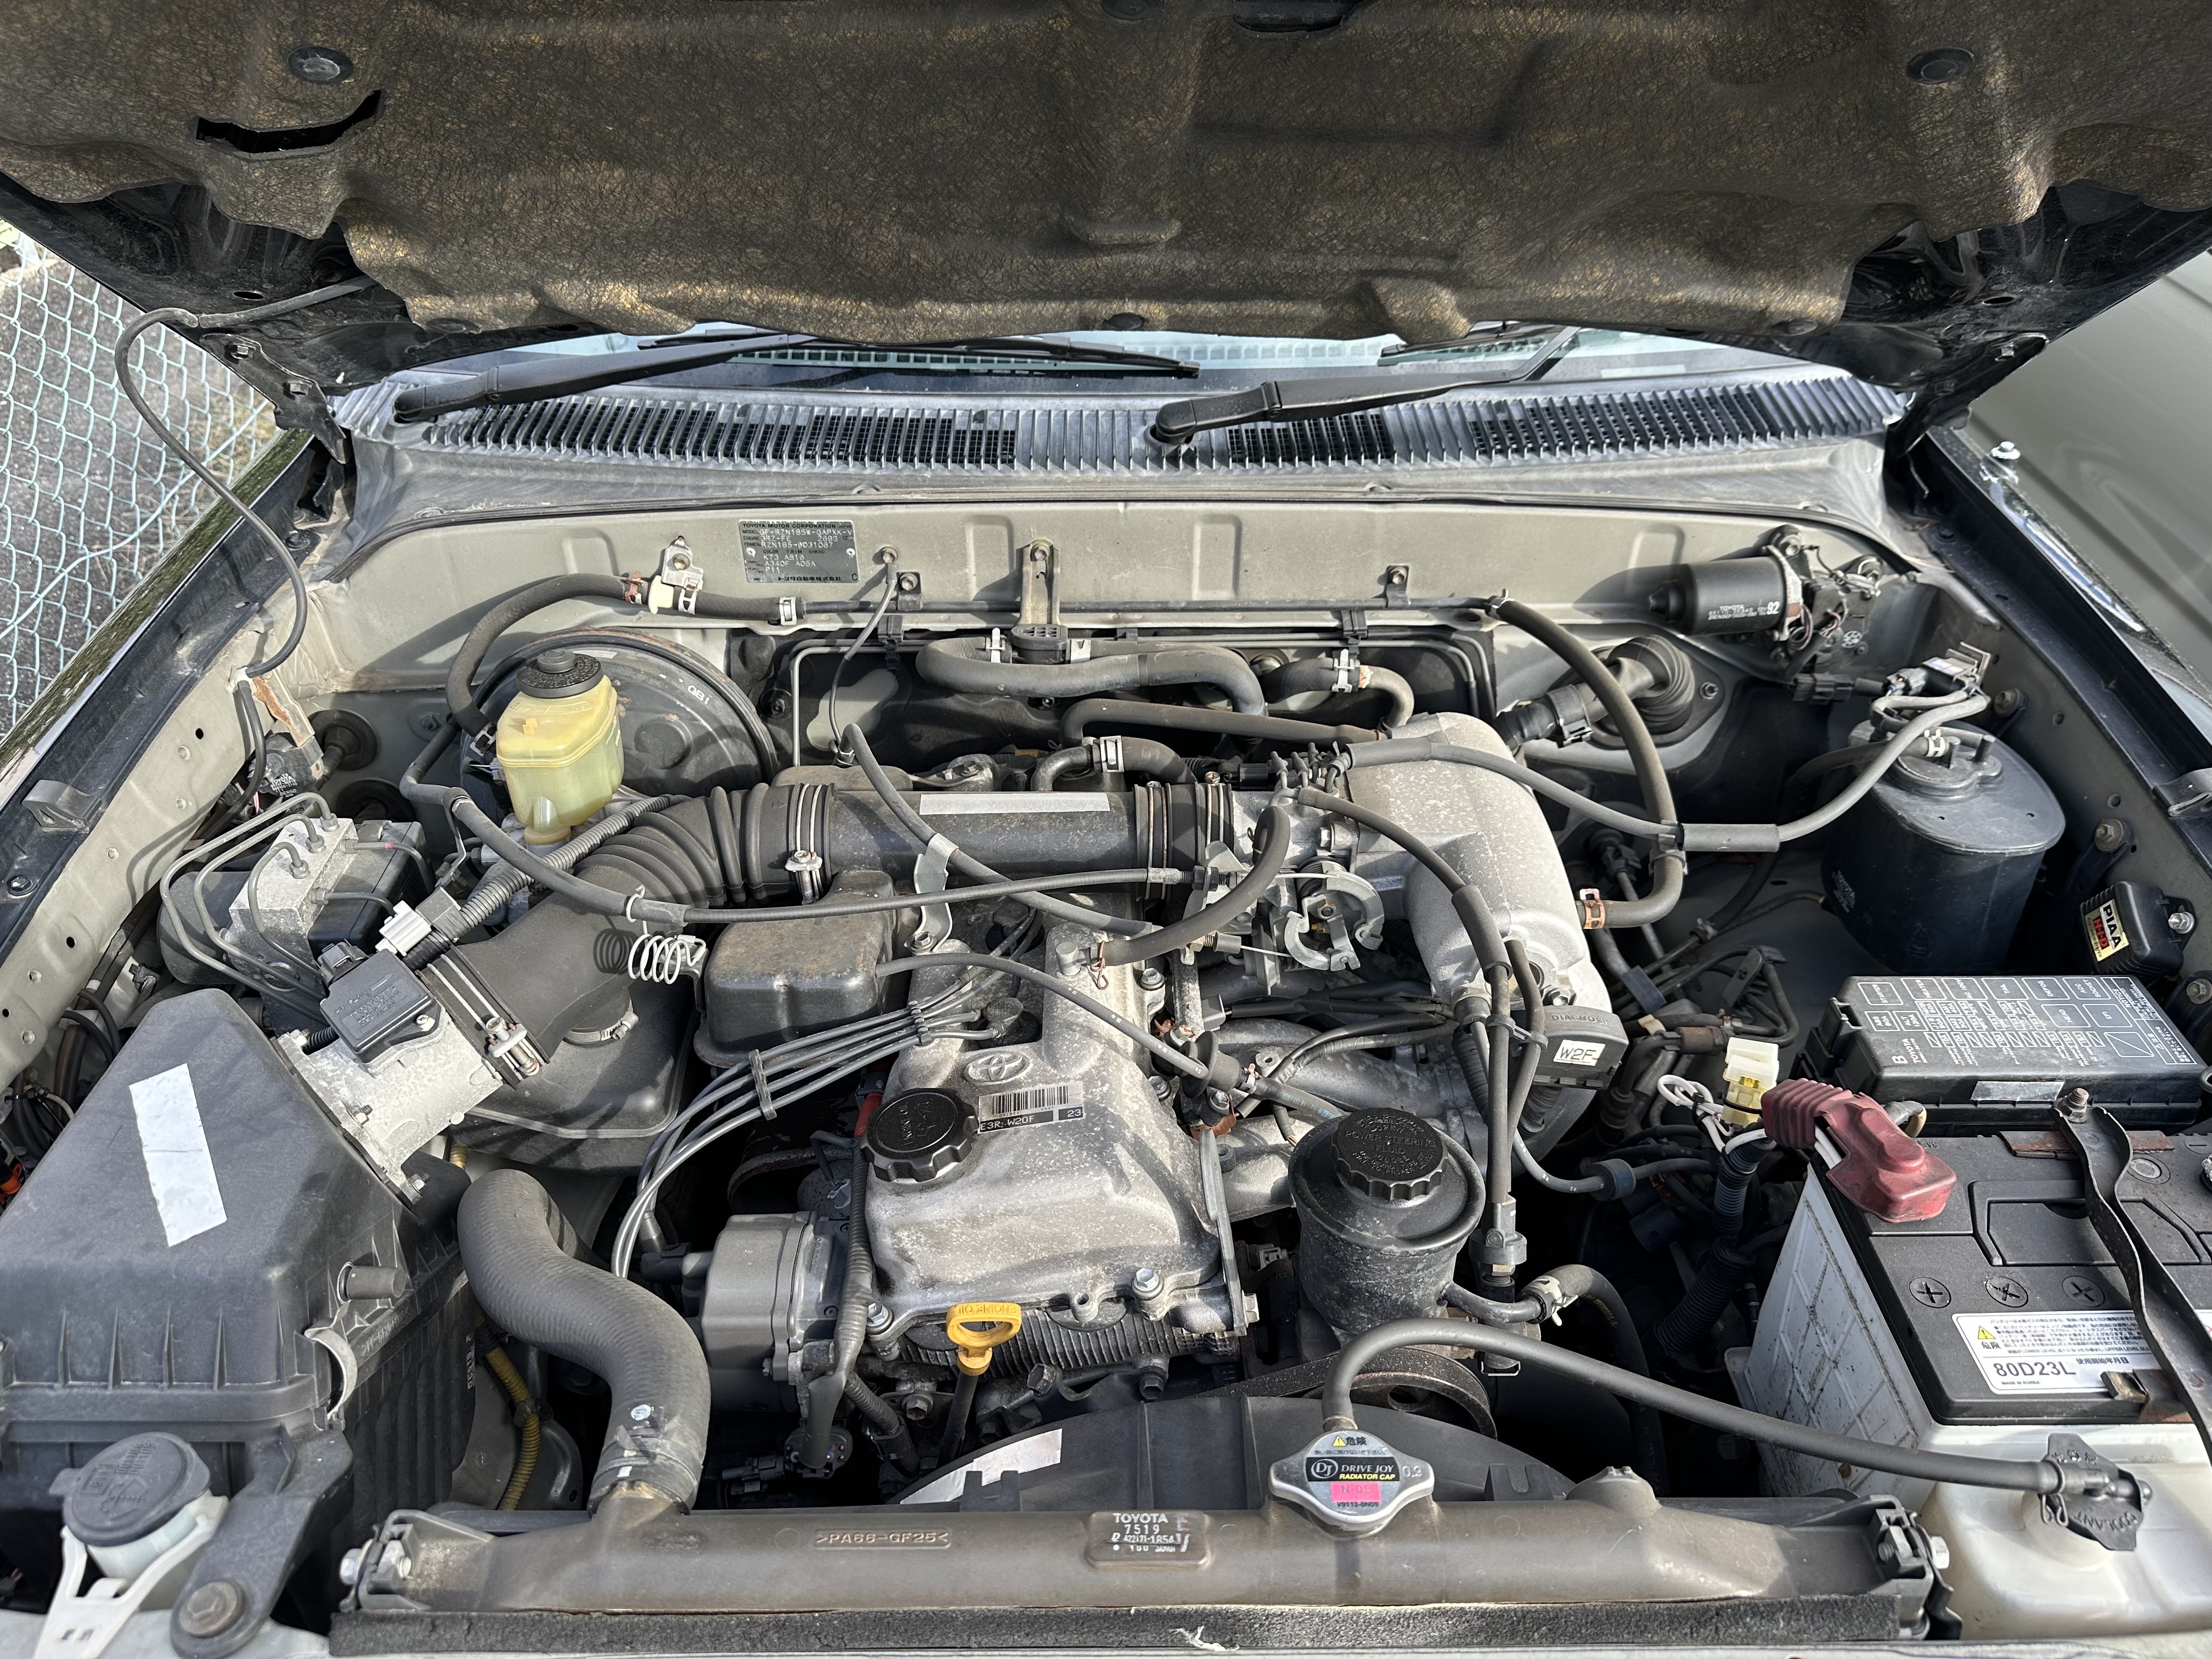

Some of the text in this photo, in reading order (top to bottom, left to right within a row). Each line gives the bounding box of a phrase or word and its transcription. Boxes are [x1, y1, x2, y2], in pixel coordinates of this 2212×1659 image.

[1767, 601, 1780, 614] 92
[2103, 904, 2121, 948] PIAA
[1871, 984, 1888, 1003] STARTER
[1916, 979, 1931, 997] HEATER
[1999, 983, 2010, 993] TAIL
[2039, 980, 2053, 996] DEFOG
[2075, 983, 2086, 992] ACC
[2083, 979, 2101, 997] SOCKET
[349, 985, 397, 1017] TOYOTA
[2113, 988, 2131, 1007] NOTICE
[1551, 1014, 1613, 1026] DIAGNOSIS
[1872, 1016, 1883, 1027] ABS
[1901, 1016, 1912, 1025] ALT
[1909, 1014, 1921, 1026] 120A
[2060, 1009, 2072, 1022] HEAD
[1560, 1046, 1597, 1061] W2F
[1900, 1038, 1922, 1063] TOYOTA
[1892, 1055, 1908, 1064] B
[1345, 1131, 1436, 1148] POWER STEERING
[1375, 1144, 1405, 1154] FLUID
[956, 1305, 1017, 1314] ENGINE OIL
[1993, 1361, 2076, 1376] 80D23L
[1346, 1436, 1367, 1446] 危険
[1341, 1464, 1394, 1473] DRIVE JOY
[1341, 1485, 1372, 1493] N-09
[1113, 1513, 1169, 1523] TOYOTA
[2074, 1511, 2137, 1531] COOLANT
[1125, 1524, 1160, 1534] 7519
